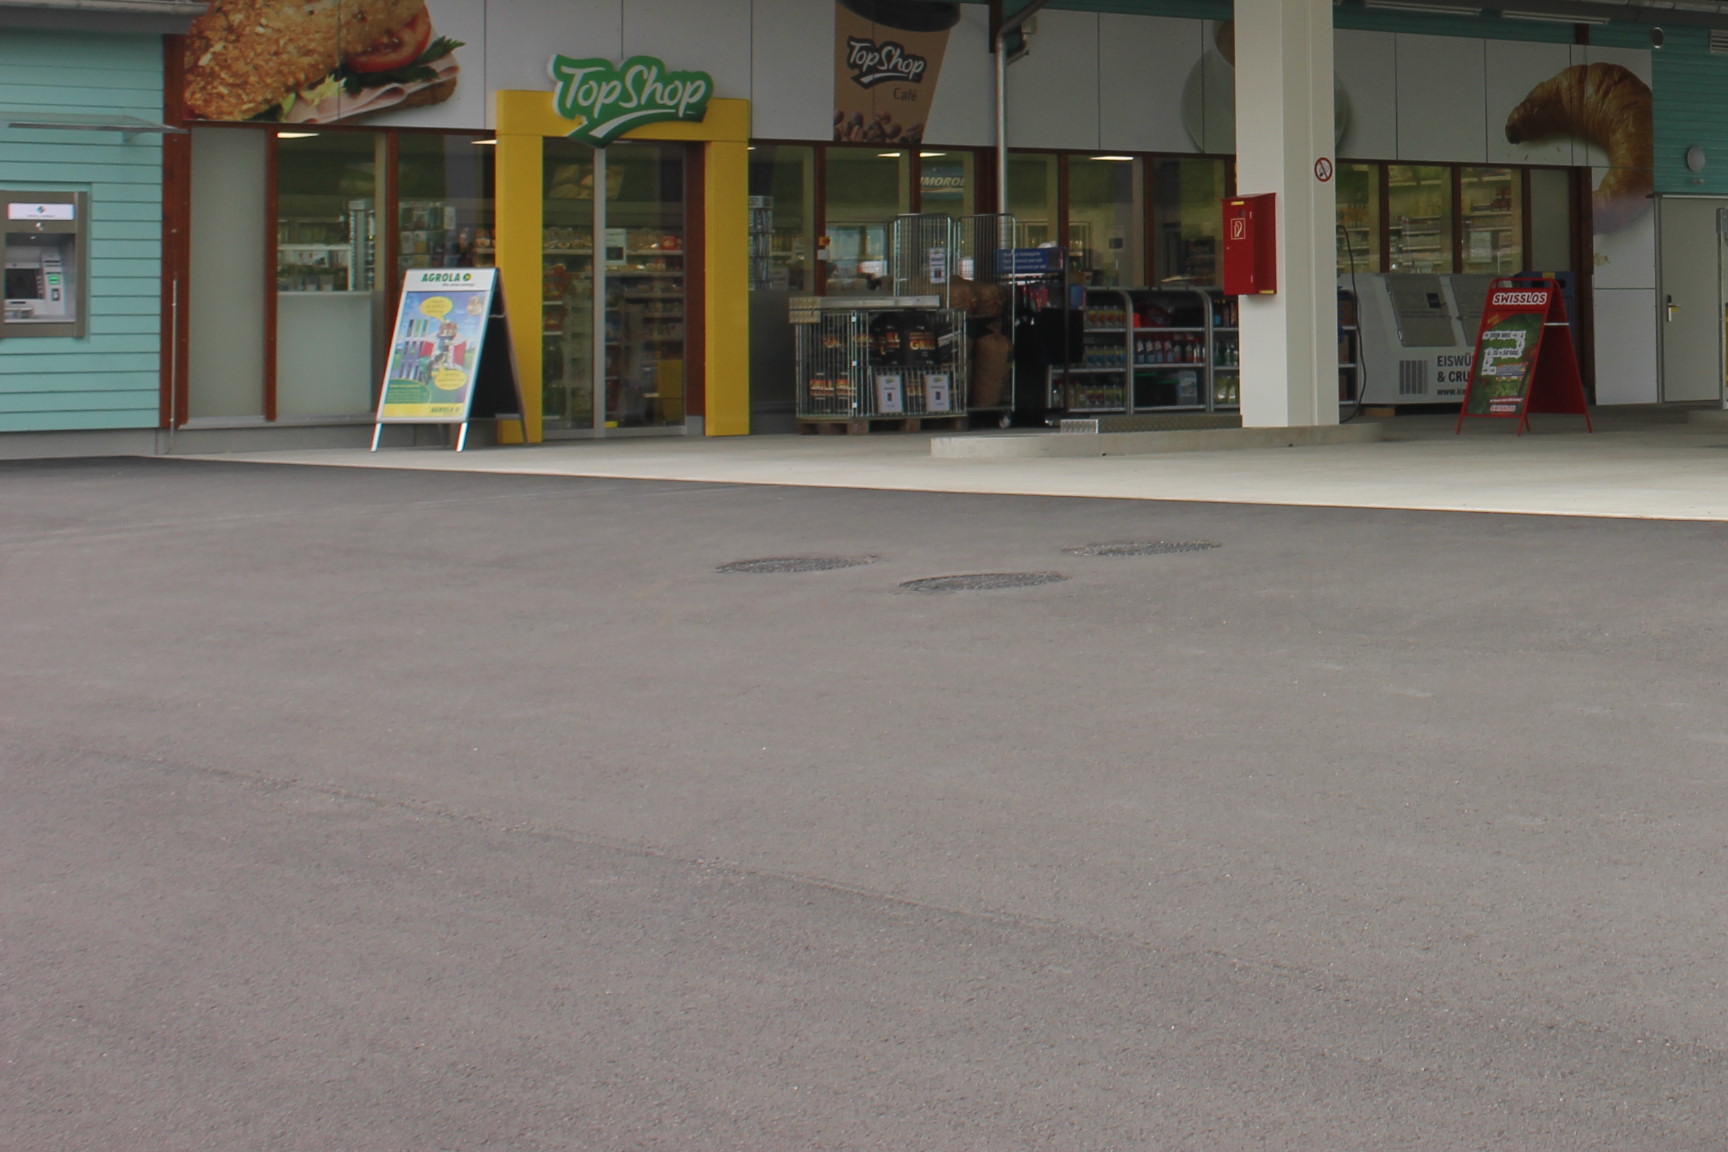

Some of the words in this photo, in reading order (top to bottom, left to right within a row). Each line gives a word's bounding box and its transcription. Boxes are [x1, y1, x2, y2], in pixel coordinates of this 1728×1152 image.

[849, 40, 925, 80] TopShop
[560, 64, 706, 120] TopShop
[892, 87, 918, 102] Café
[421, 273, 461, 282] AGROLA
[1493, 292, 1547, 305] SWISSLOS
[1437, 352, 1472, 367] EISWÜ
[1437, 371, 1446, 383] &
